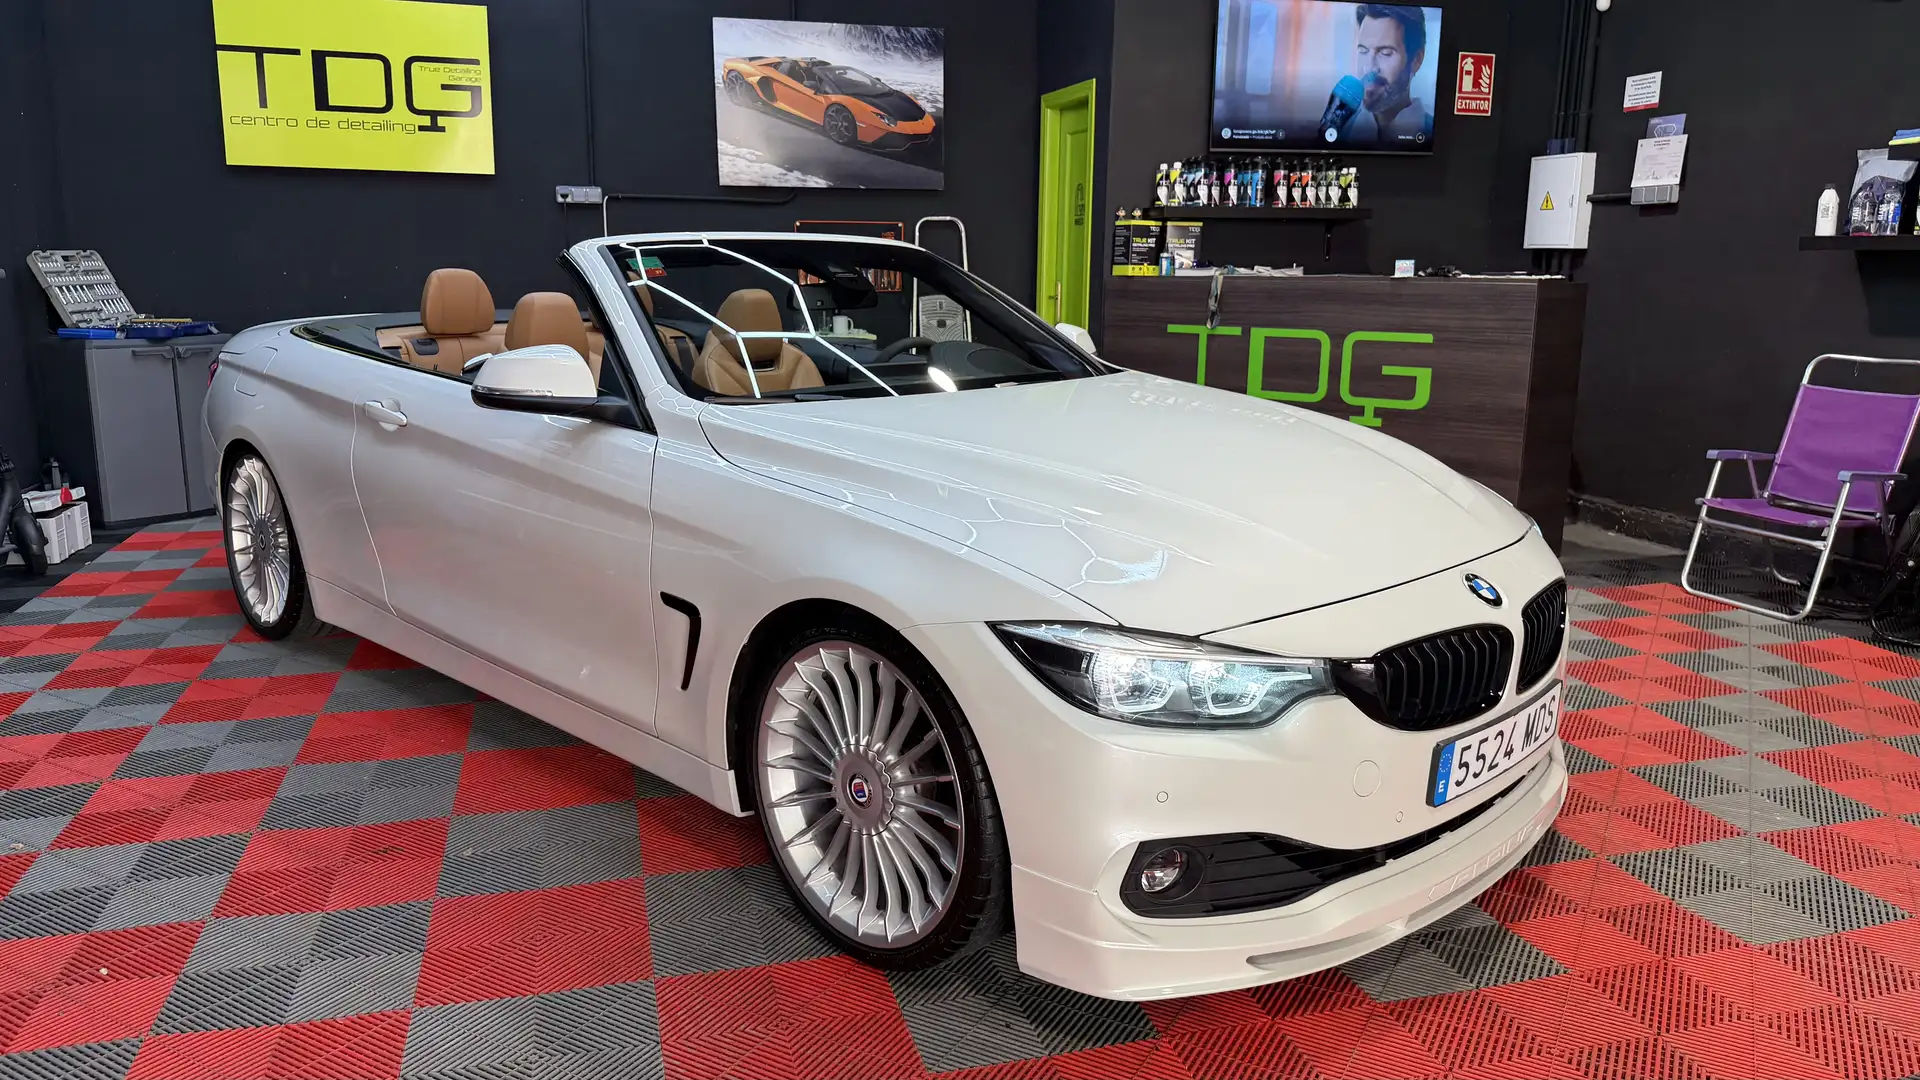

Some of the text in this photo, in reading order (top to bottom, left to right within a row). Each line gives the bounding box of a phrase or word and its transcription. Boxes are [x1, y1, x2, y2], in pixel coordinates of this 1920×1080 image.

[418, 65, 482, 76] True Detailing
[448, 74, 482, 83] Garage
[216, 44, 482, 132] TDG
[1457, 99, 1489, 110] EXTINTOR
[229, 115, 416, 134] centro de detailing
[1167, 324, 1434, 426] TDG
[1455, 694, 1556, 788] 5524 MDS
[1438, 779, 1446, 793] E
